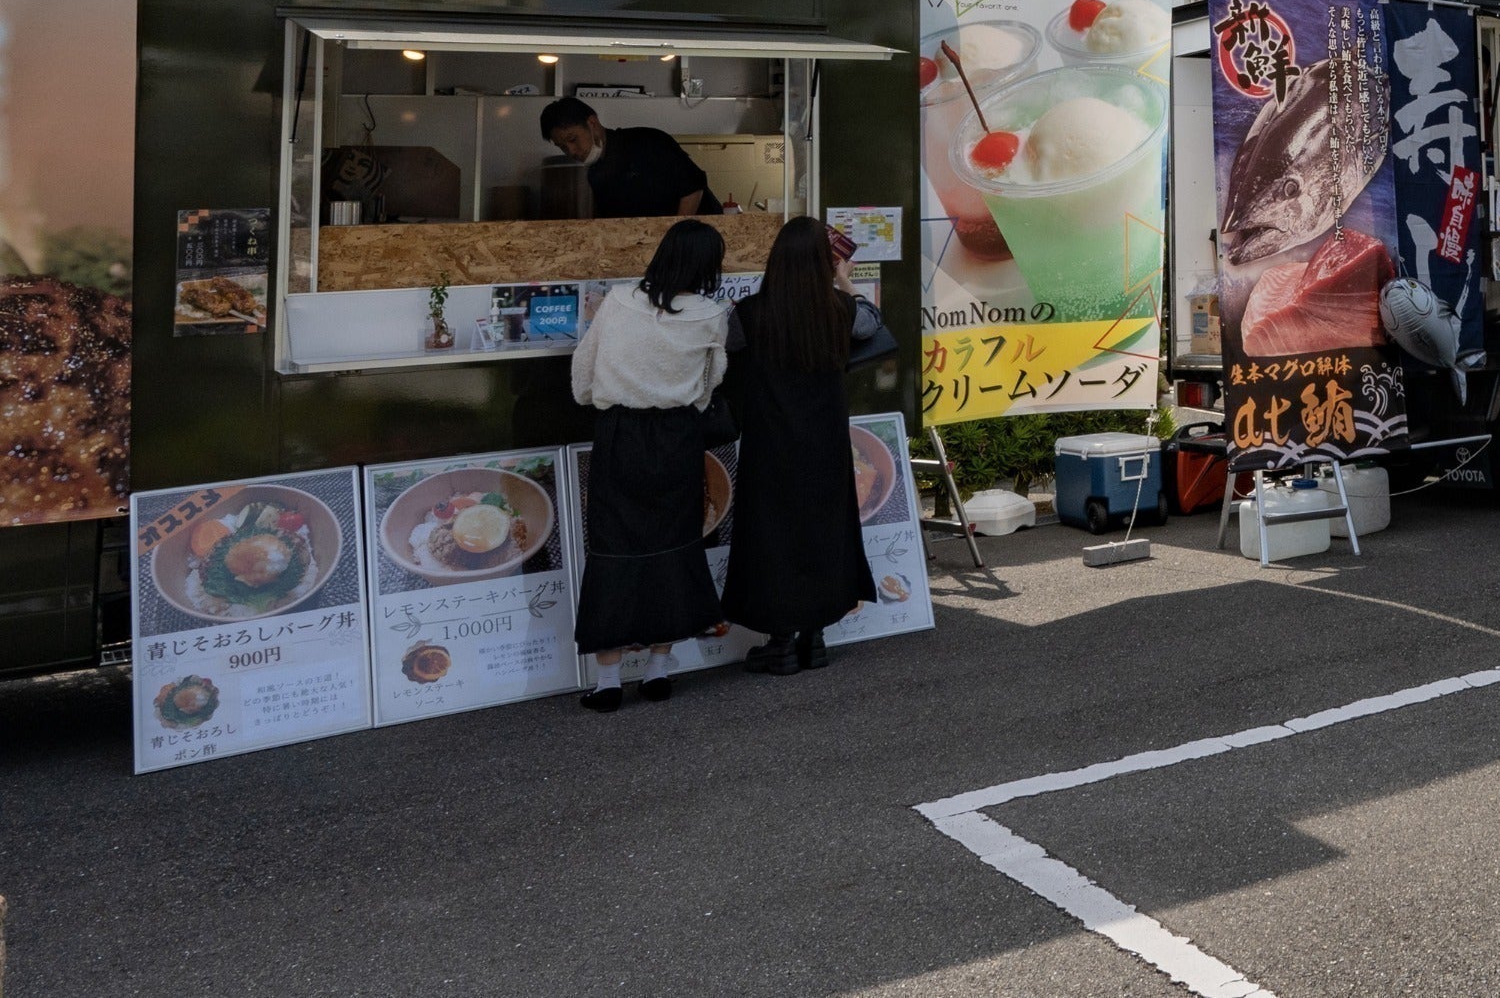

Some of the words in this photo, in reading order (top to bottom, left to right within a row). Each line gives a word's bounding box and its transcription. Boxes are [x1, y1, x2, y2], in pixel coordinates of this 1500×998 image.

[1341, 7, 1356, 154] 美味しい鮪を食べてもらいたい
[247, 218, 258, 255] つくね串
[535, 304, 572, 314] COFFEE
[539, 316, 567, 325] 200円
[923, 334, 1047, 376] カラフル
[1230, 354, 1352, 385] 生本マグロ解体
[921, 363, 1147, 413] クリームソーダ
[1444, 469, 1486, 483] TOYOTA
[138, 489, 222, 547] オススメ
[384, 579, 566, 619] レモンステーキバーグ丼
[147, 610, 356, 660] 青じそおろしバーグ丼
[443, 615, 512, 641] 1,000円
[229, 646, 281, 669] 900円
[393, 679, 465, 699] レモンステーキ
[415, 697, 445, 709] ソース
[151, 723, 237, 750] 青じそおろし
[174, 744, 217, 761] ポン酢
